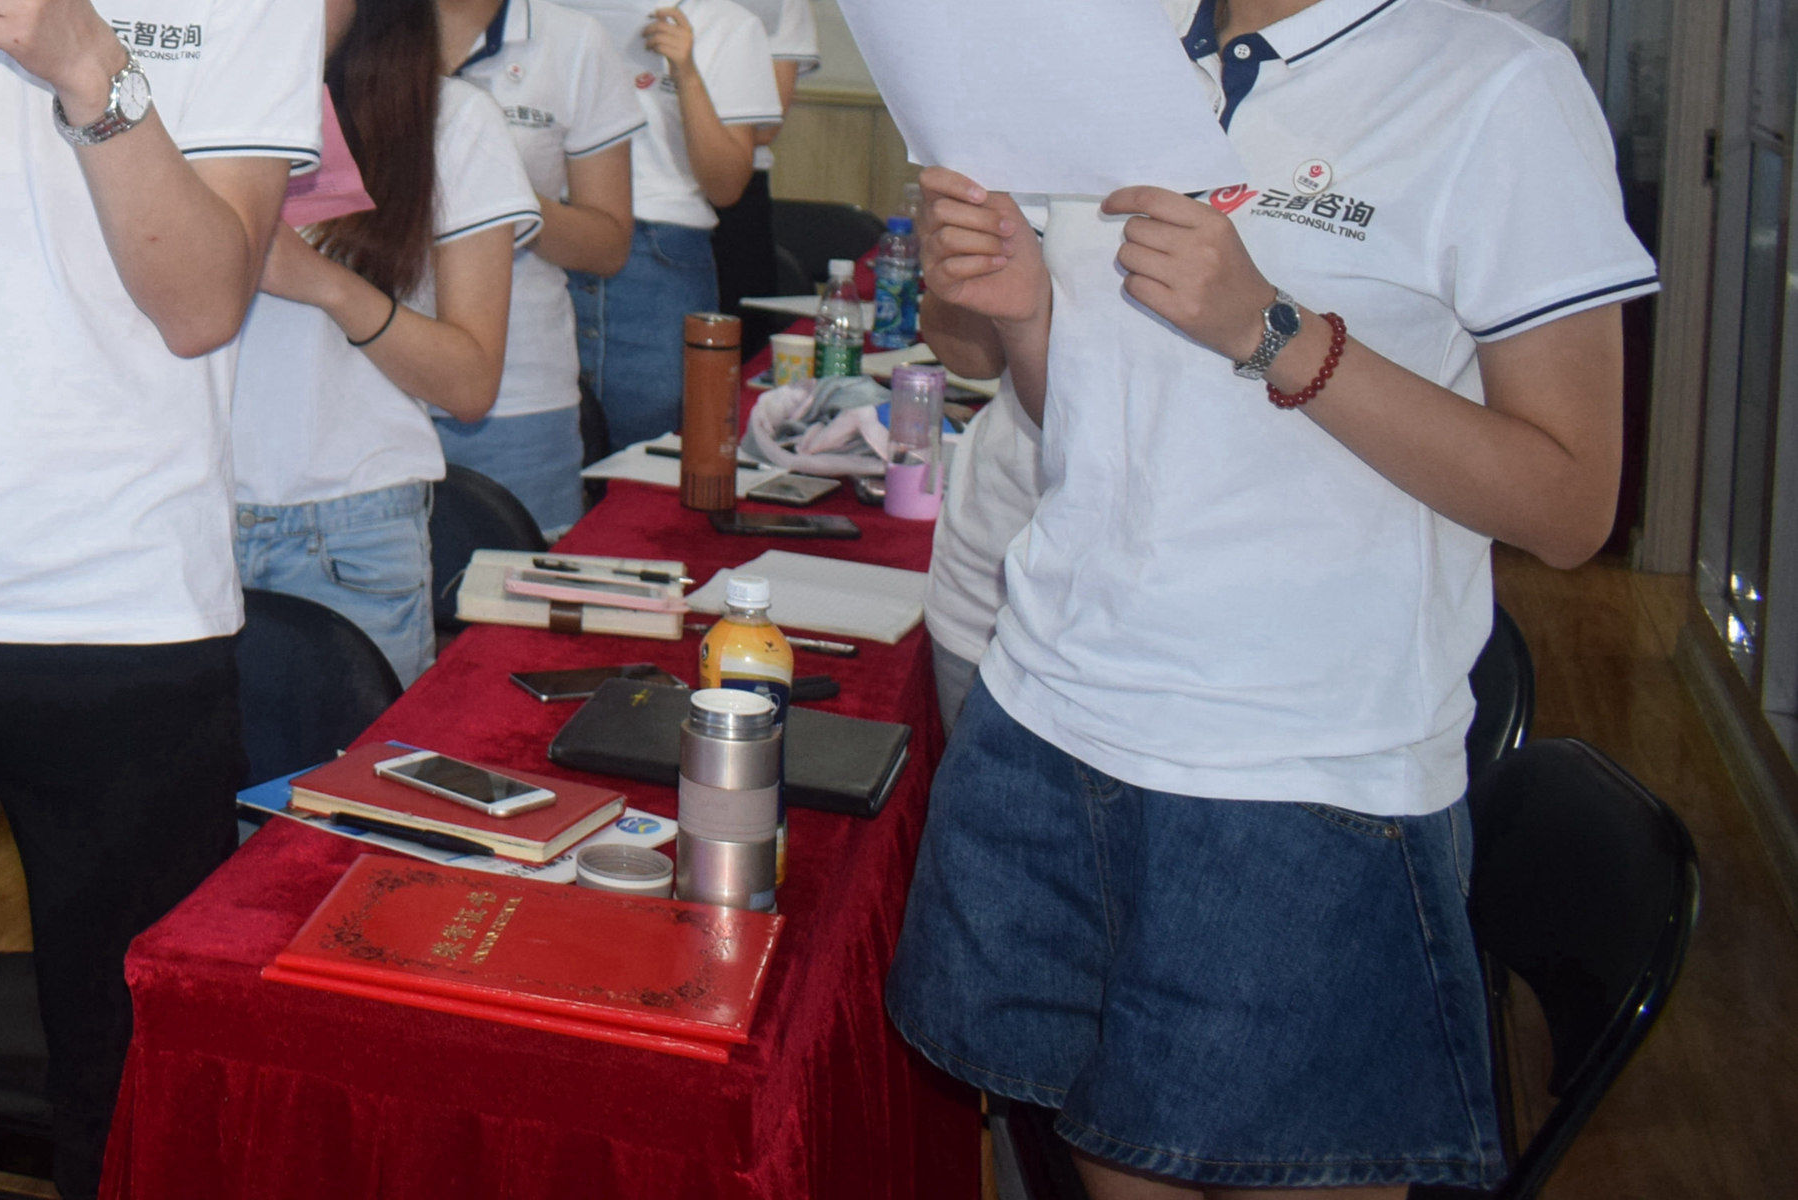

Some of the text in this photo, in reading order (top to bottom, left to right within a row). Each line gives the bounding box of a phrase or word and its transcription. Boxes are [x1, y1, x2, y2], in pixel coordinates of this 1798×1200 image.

[112, 19, 202, 50] 云智咨询
[1258, 188, 1376, 228] 云智咨询
